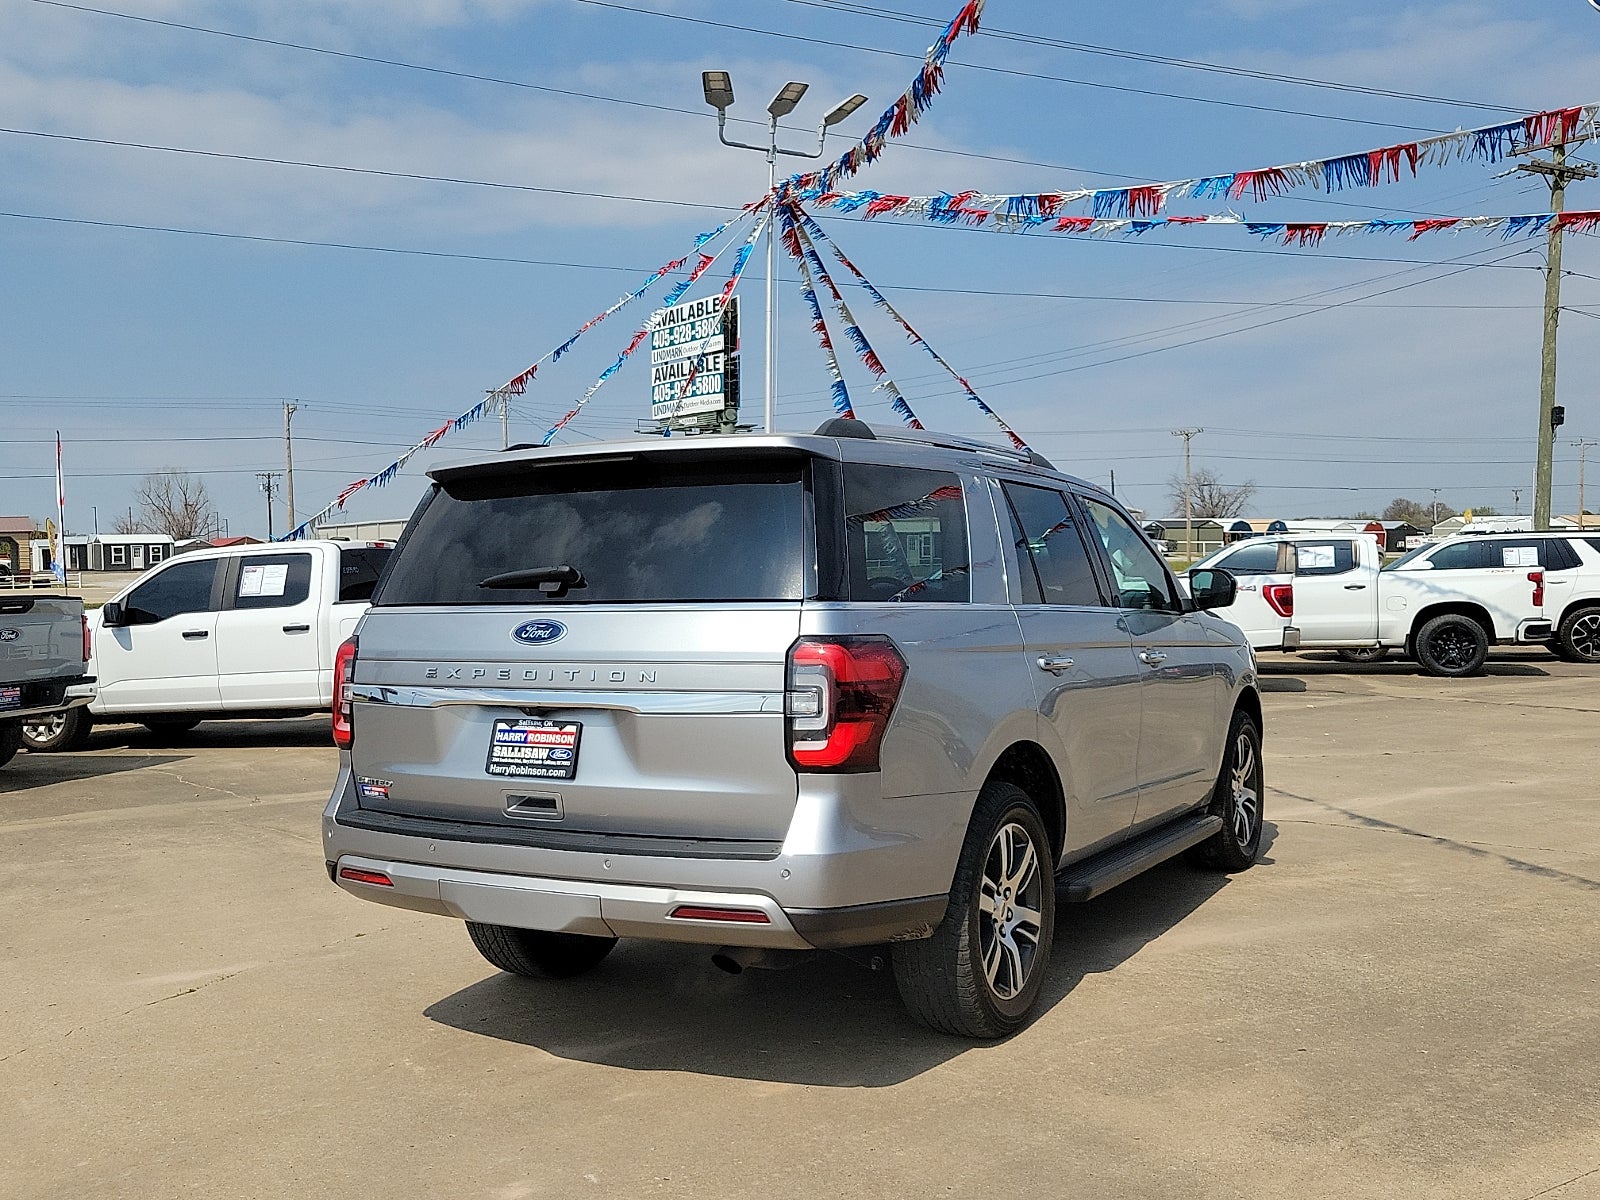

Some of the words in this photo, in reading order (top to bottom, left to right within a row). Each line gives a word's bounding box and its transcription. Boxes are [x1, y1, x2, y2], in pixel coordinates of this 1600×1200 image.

[653, 346, 683, 362] LINDMARK
[0, 629, 18, 640] Ford
[519, 622, 555, 639] Ford
[425, 667, 657, 683] EXPEDITION
[496, 731, 527, 742] HARRY
[527, 733, 575, 744] ROBINSON
[492, 745, 550, 760] SALLISAW
[489, 763, 567, 778] HarryRobinson.com
